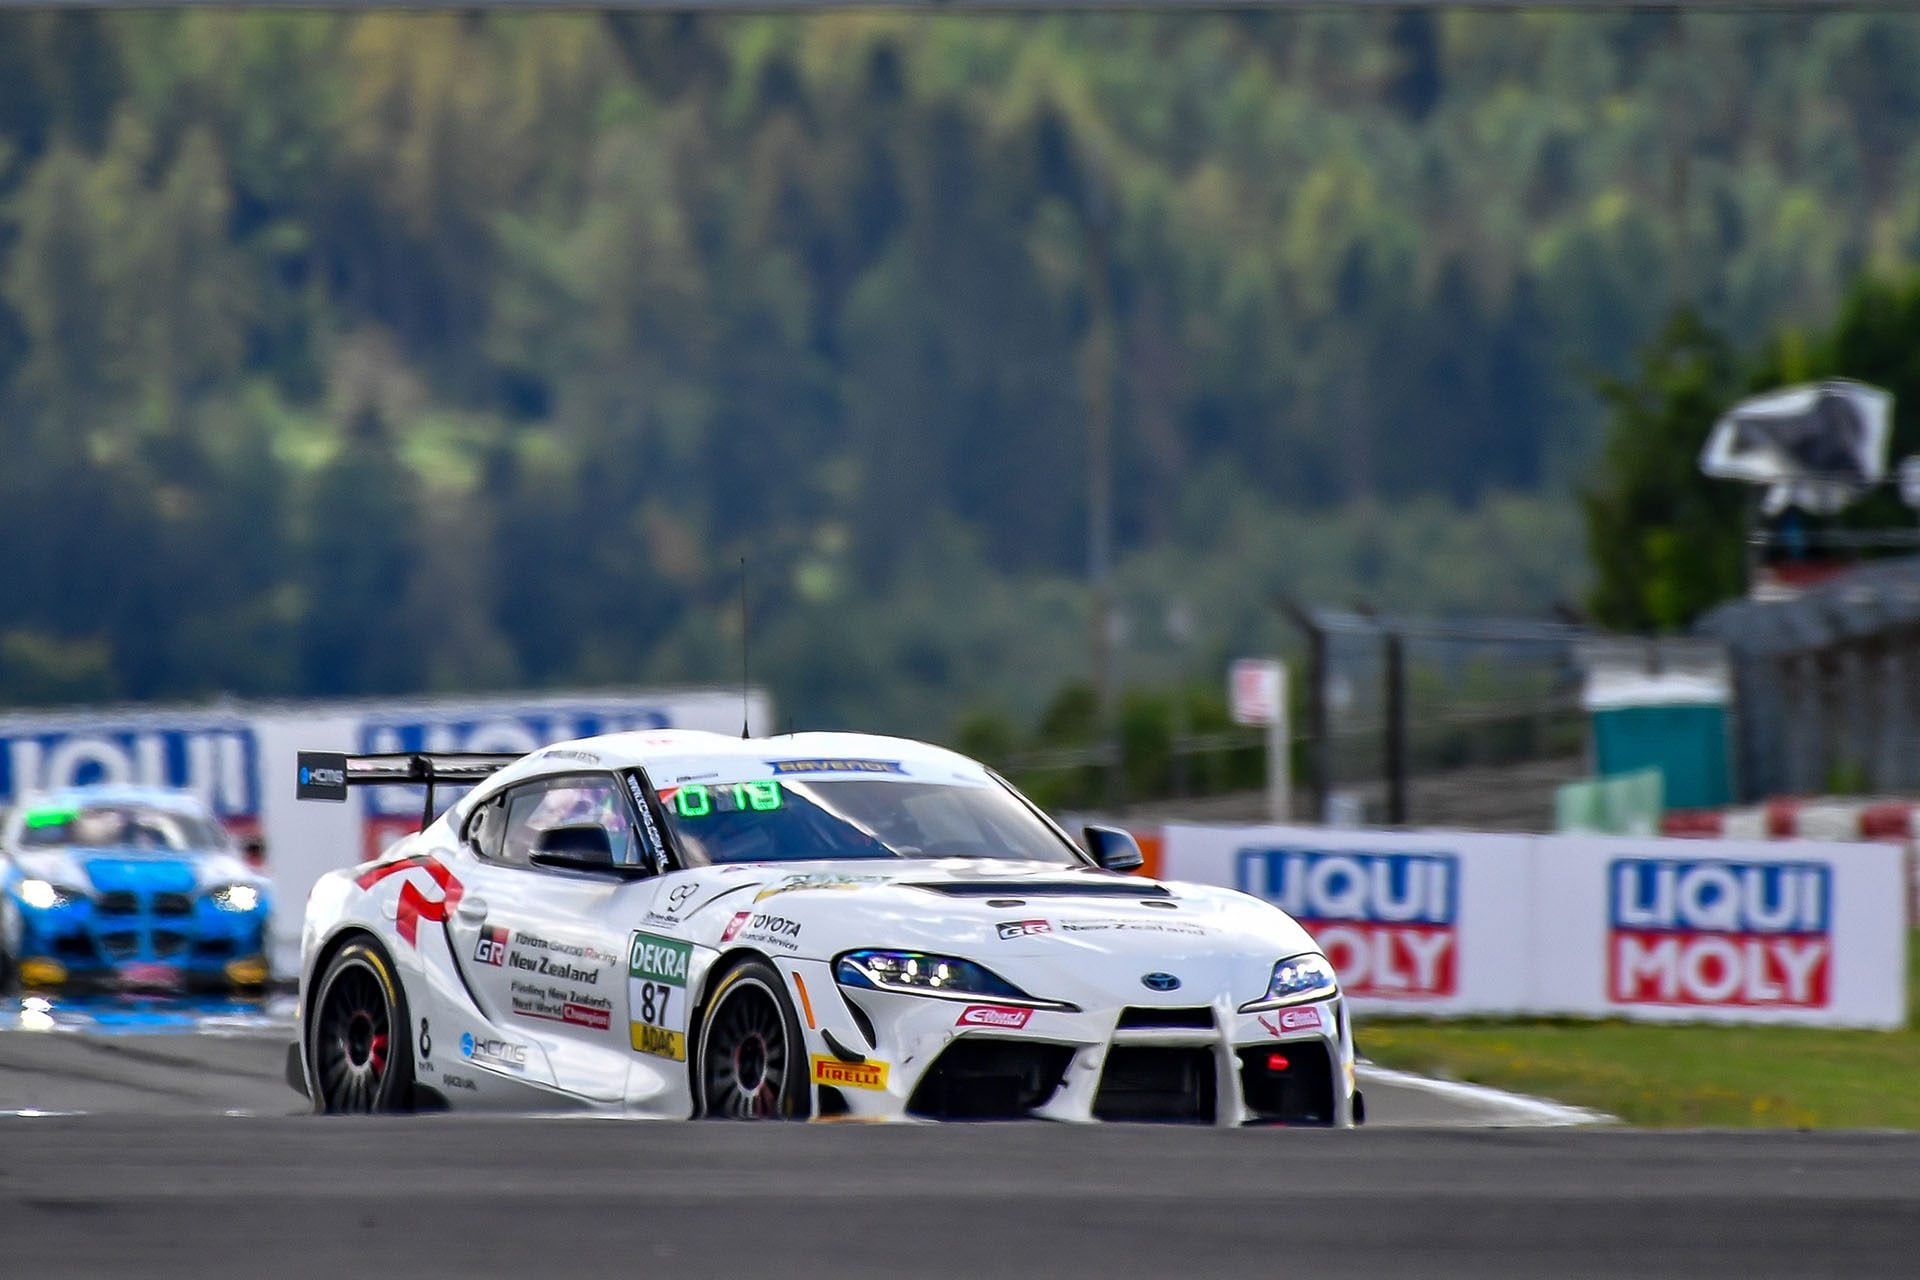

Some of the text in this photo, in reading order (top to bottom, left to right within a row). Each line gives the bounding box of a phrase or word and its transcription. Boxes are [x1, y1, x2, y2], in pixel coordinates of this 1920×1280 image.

[1620, 865, 1822, 930] LIQUI
[515, 932, 549, 949] TOYOTA
[748, 914, 802, 938] TOYOTA
[1000, 924, 1050, 939] GR
[475, 938, 504, 965] GR
[632, 941, 687, 980] DEKRA
[767, 936, 799, 952] Services
[1314, 927, 1455, 989] OLY
[509, 950, 599, 985] New Zealand
[1618, 935, 1828, 1001] MOLY
[641, 981, 671, 1027] 87
[643, 1025, 675, 1059] ADAC
[816, 1060, 882, 1085] PIRELLI
